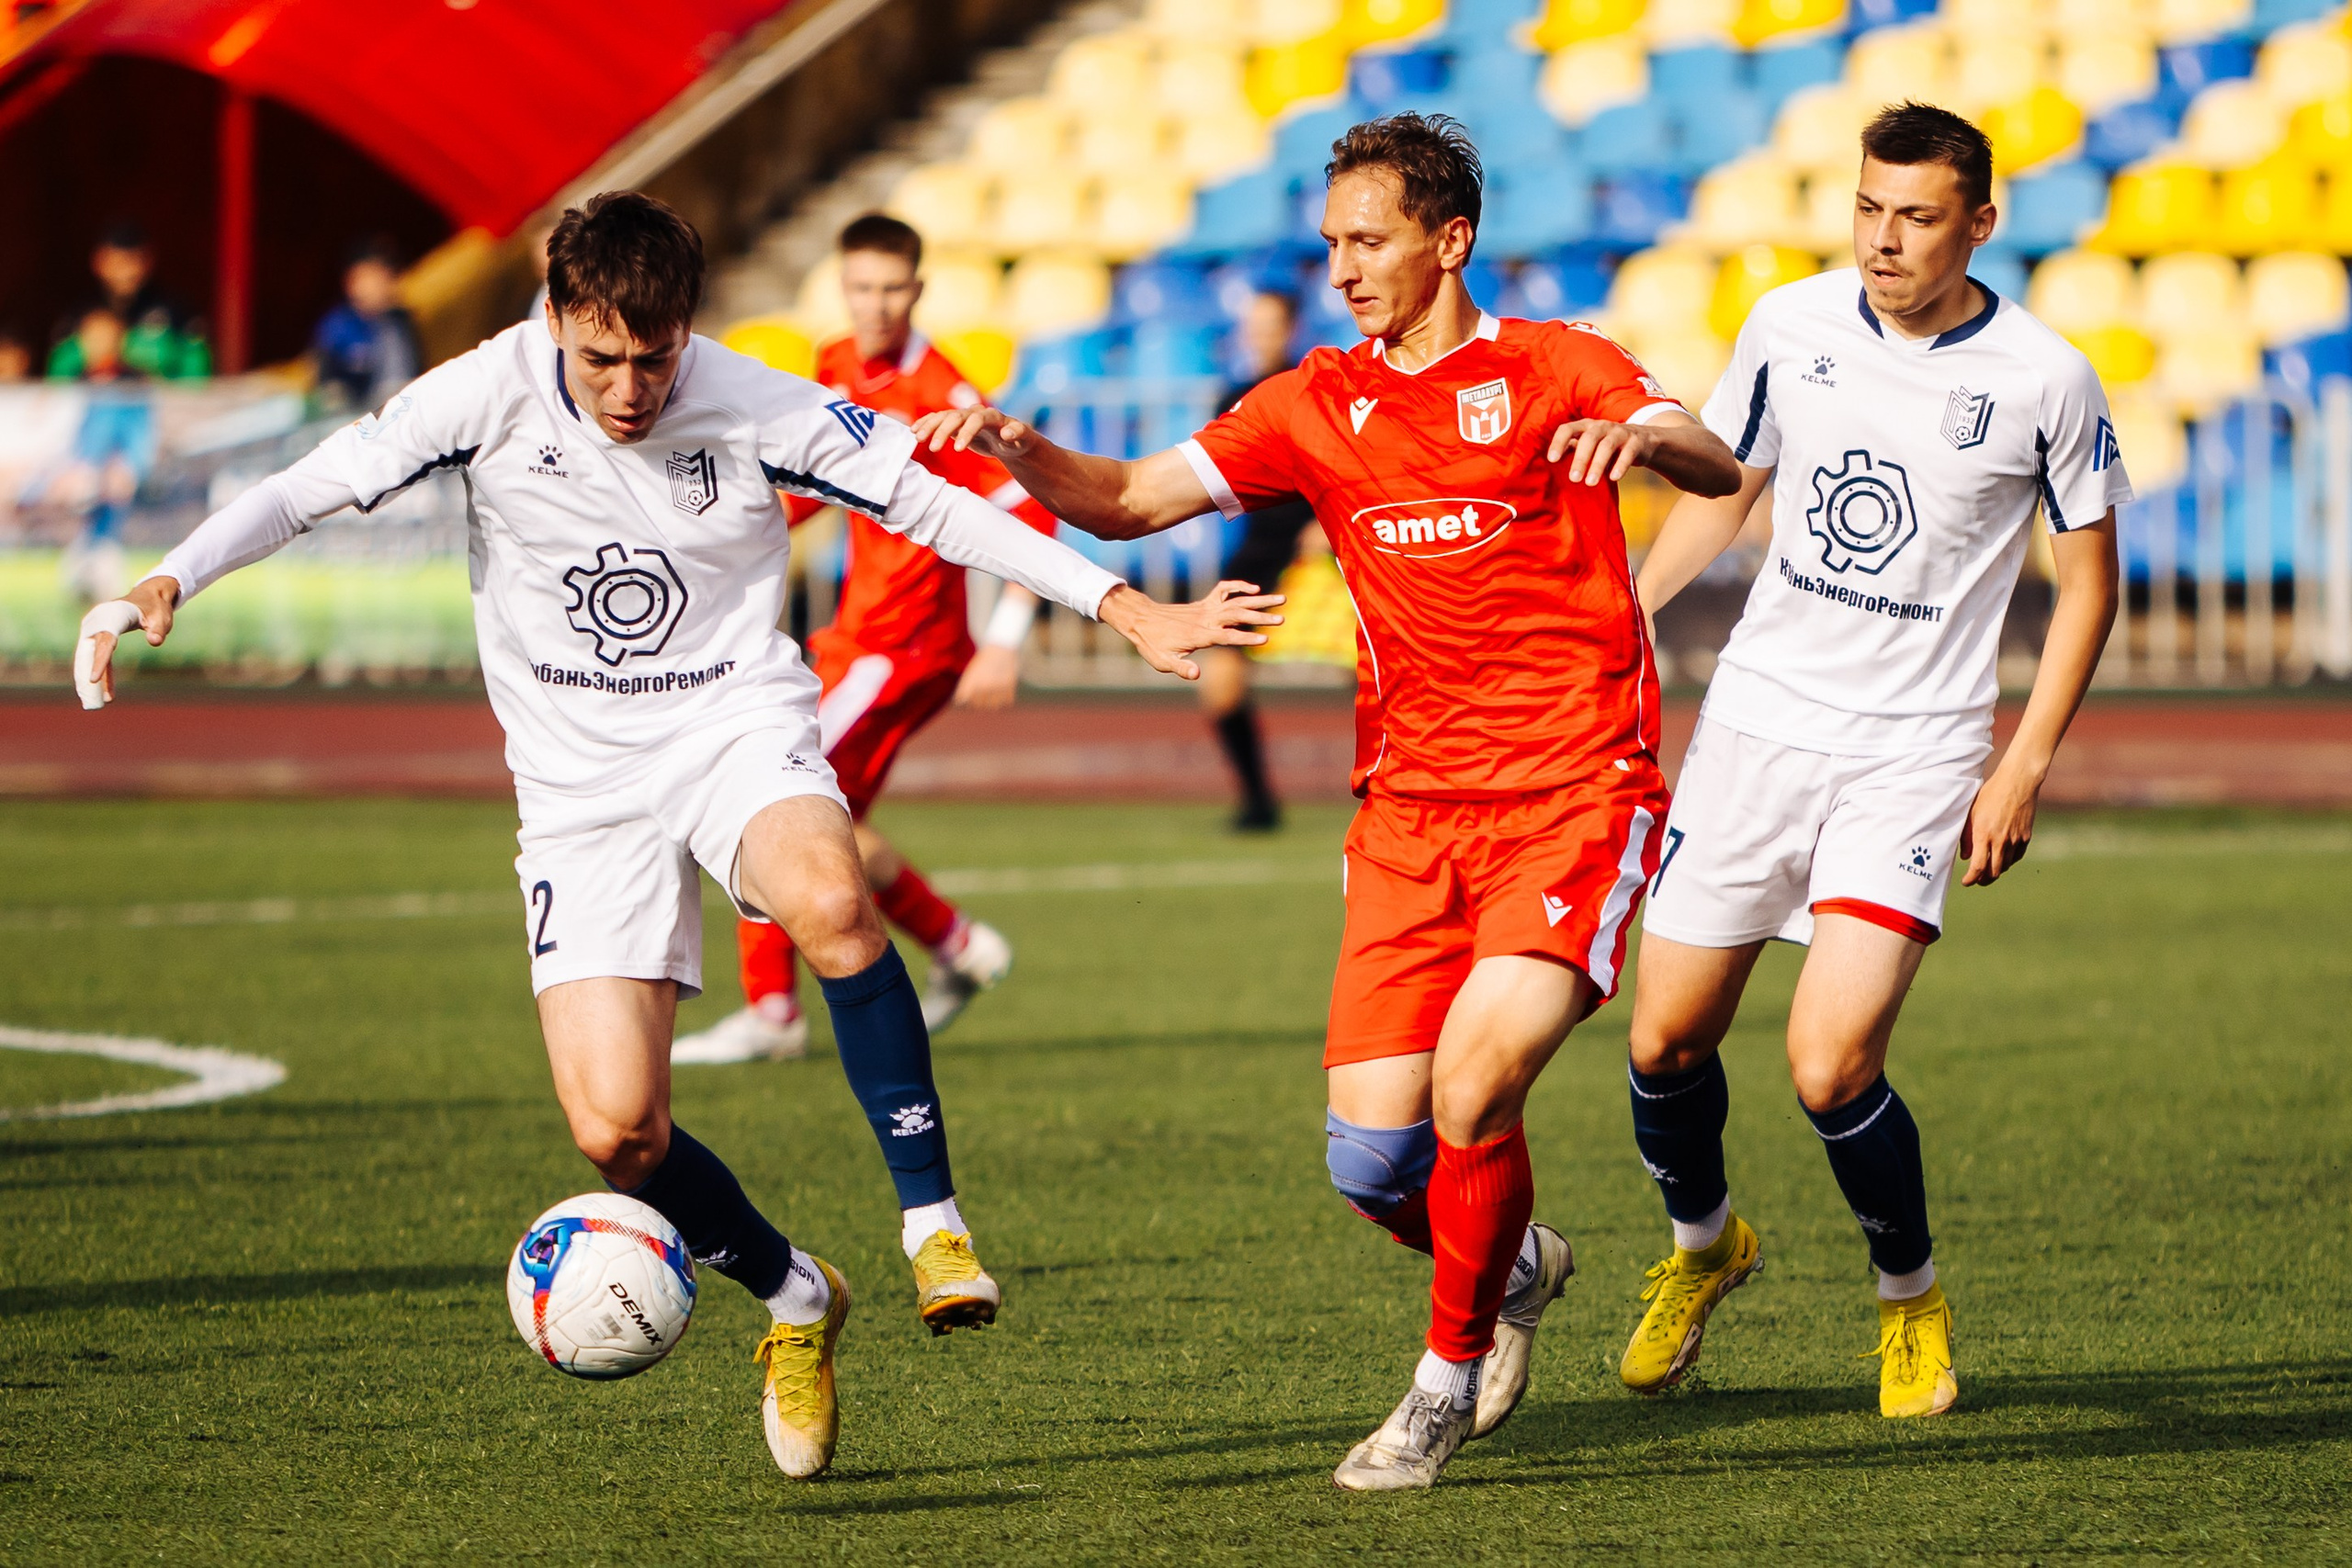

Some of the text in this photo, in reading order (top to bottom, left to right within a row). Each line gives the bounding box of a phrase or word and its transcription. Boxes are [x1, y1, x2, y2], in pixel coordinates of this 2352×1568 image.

[1800, 373, 1838, 388] KELME
[527, 466, 570, 479] KELME
[1372, 504, 1482, 544] amet
[1651, 825, 1686, 898] 7
[1898, 863, 1933, 882] KELME
[532, 879, 558, 959] 2
[891, 1120, 935, 1137] KELME
[608, 1282, 663, 1347] DEMIX
